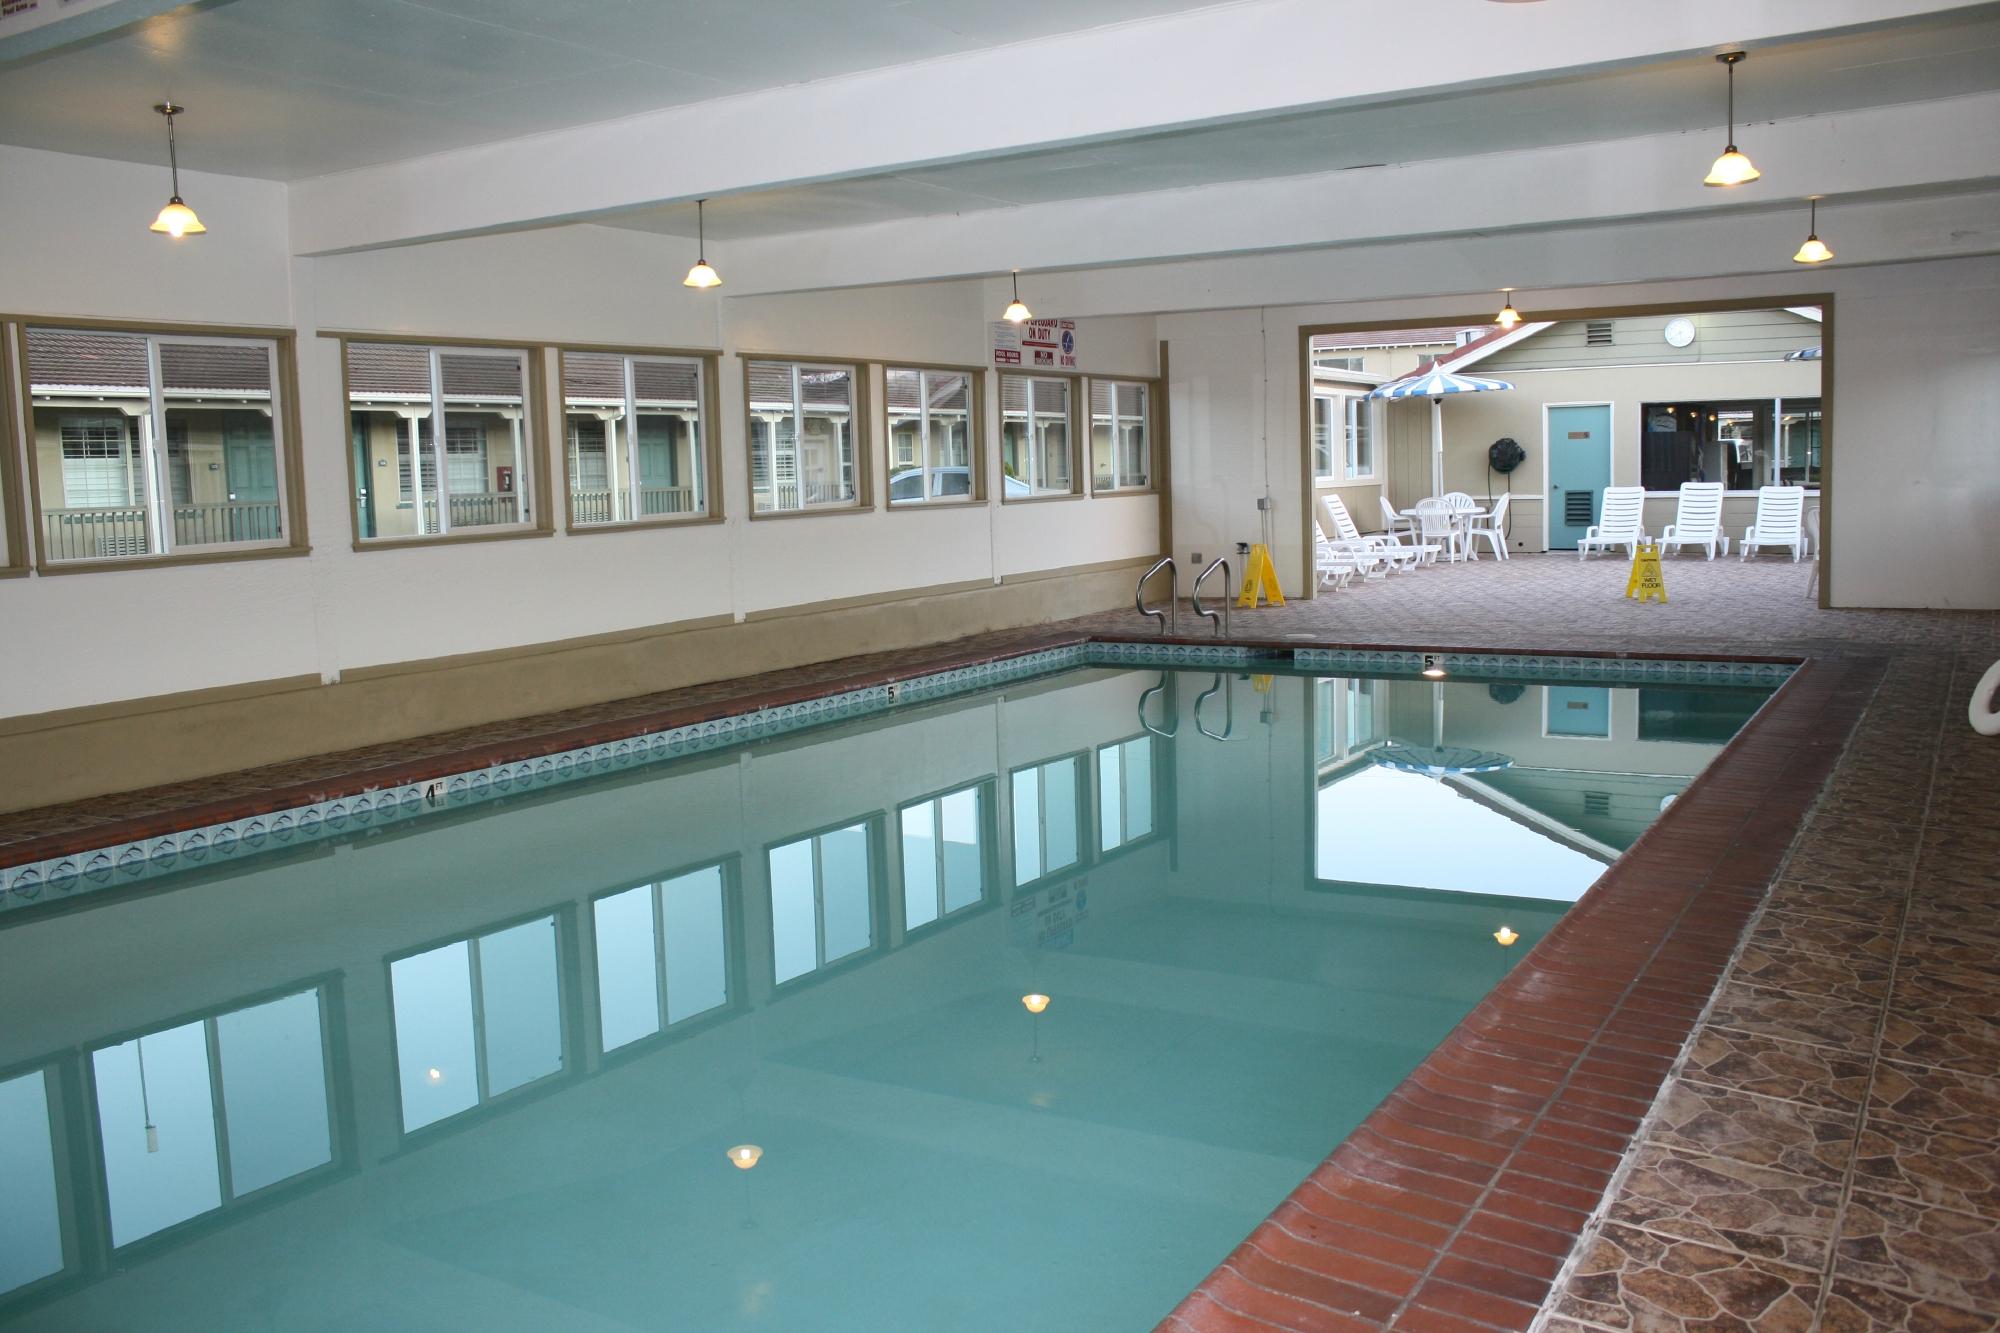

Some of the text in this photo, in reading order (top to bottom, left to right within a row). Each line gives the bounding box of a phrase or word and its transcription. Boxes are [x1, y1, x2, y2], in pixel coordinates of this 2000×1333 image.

[1029, 326, 1036, 339] ON
[1038, 327, 1051, 340] DUTY
[1425, 655, 1433, 664] 5
[888, 687, 894, 697] 5
[435, 782, 443, 790] FT
